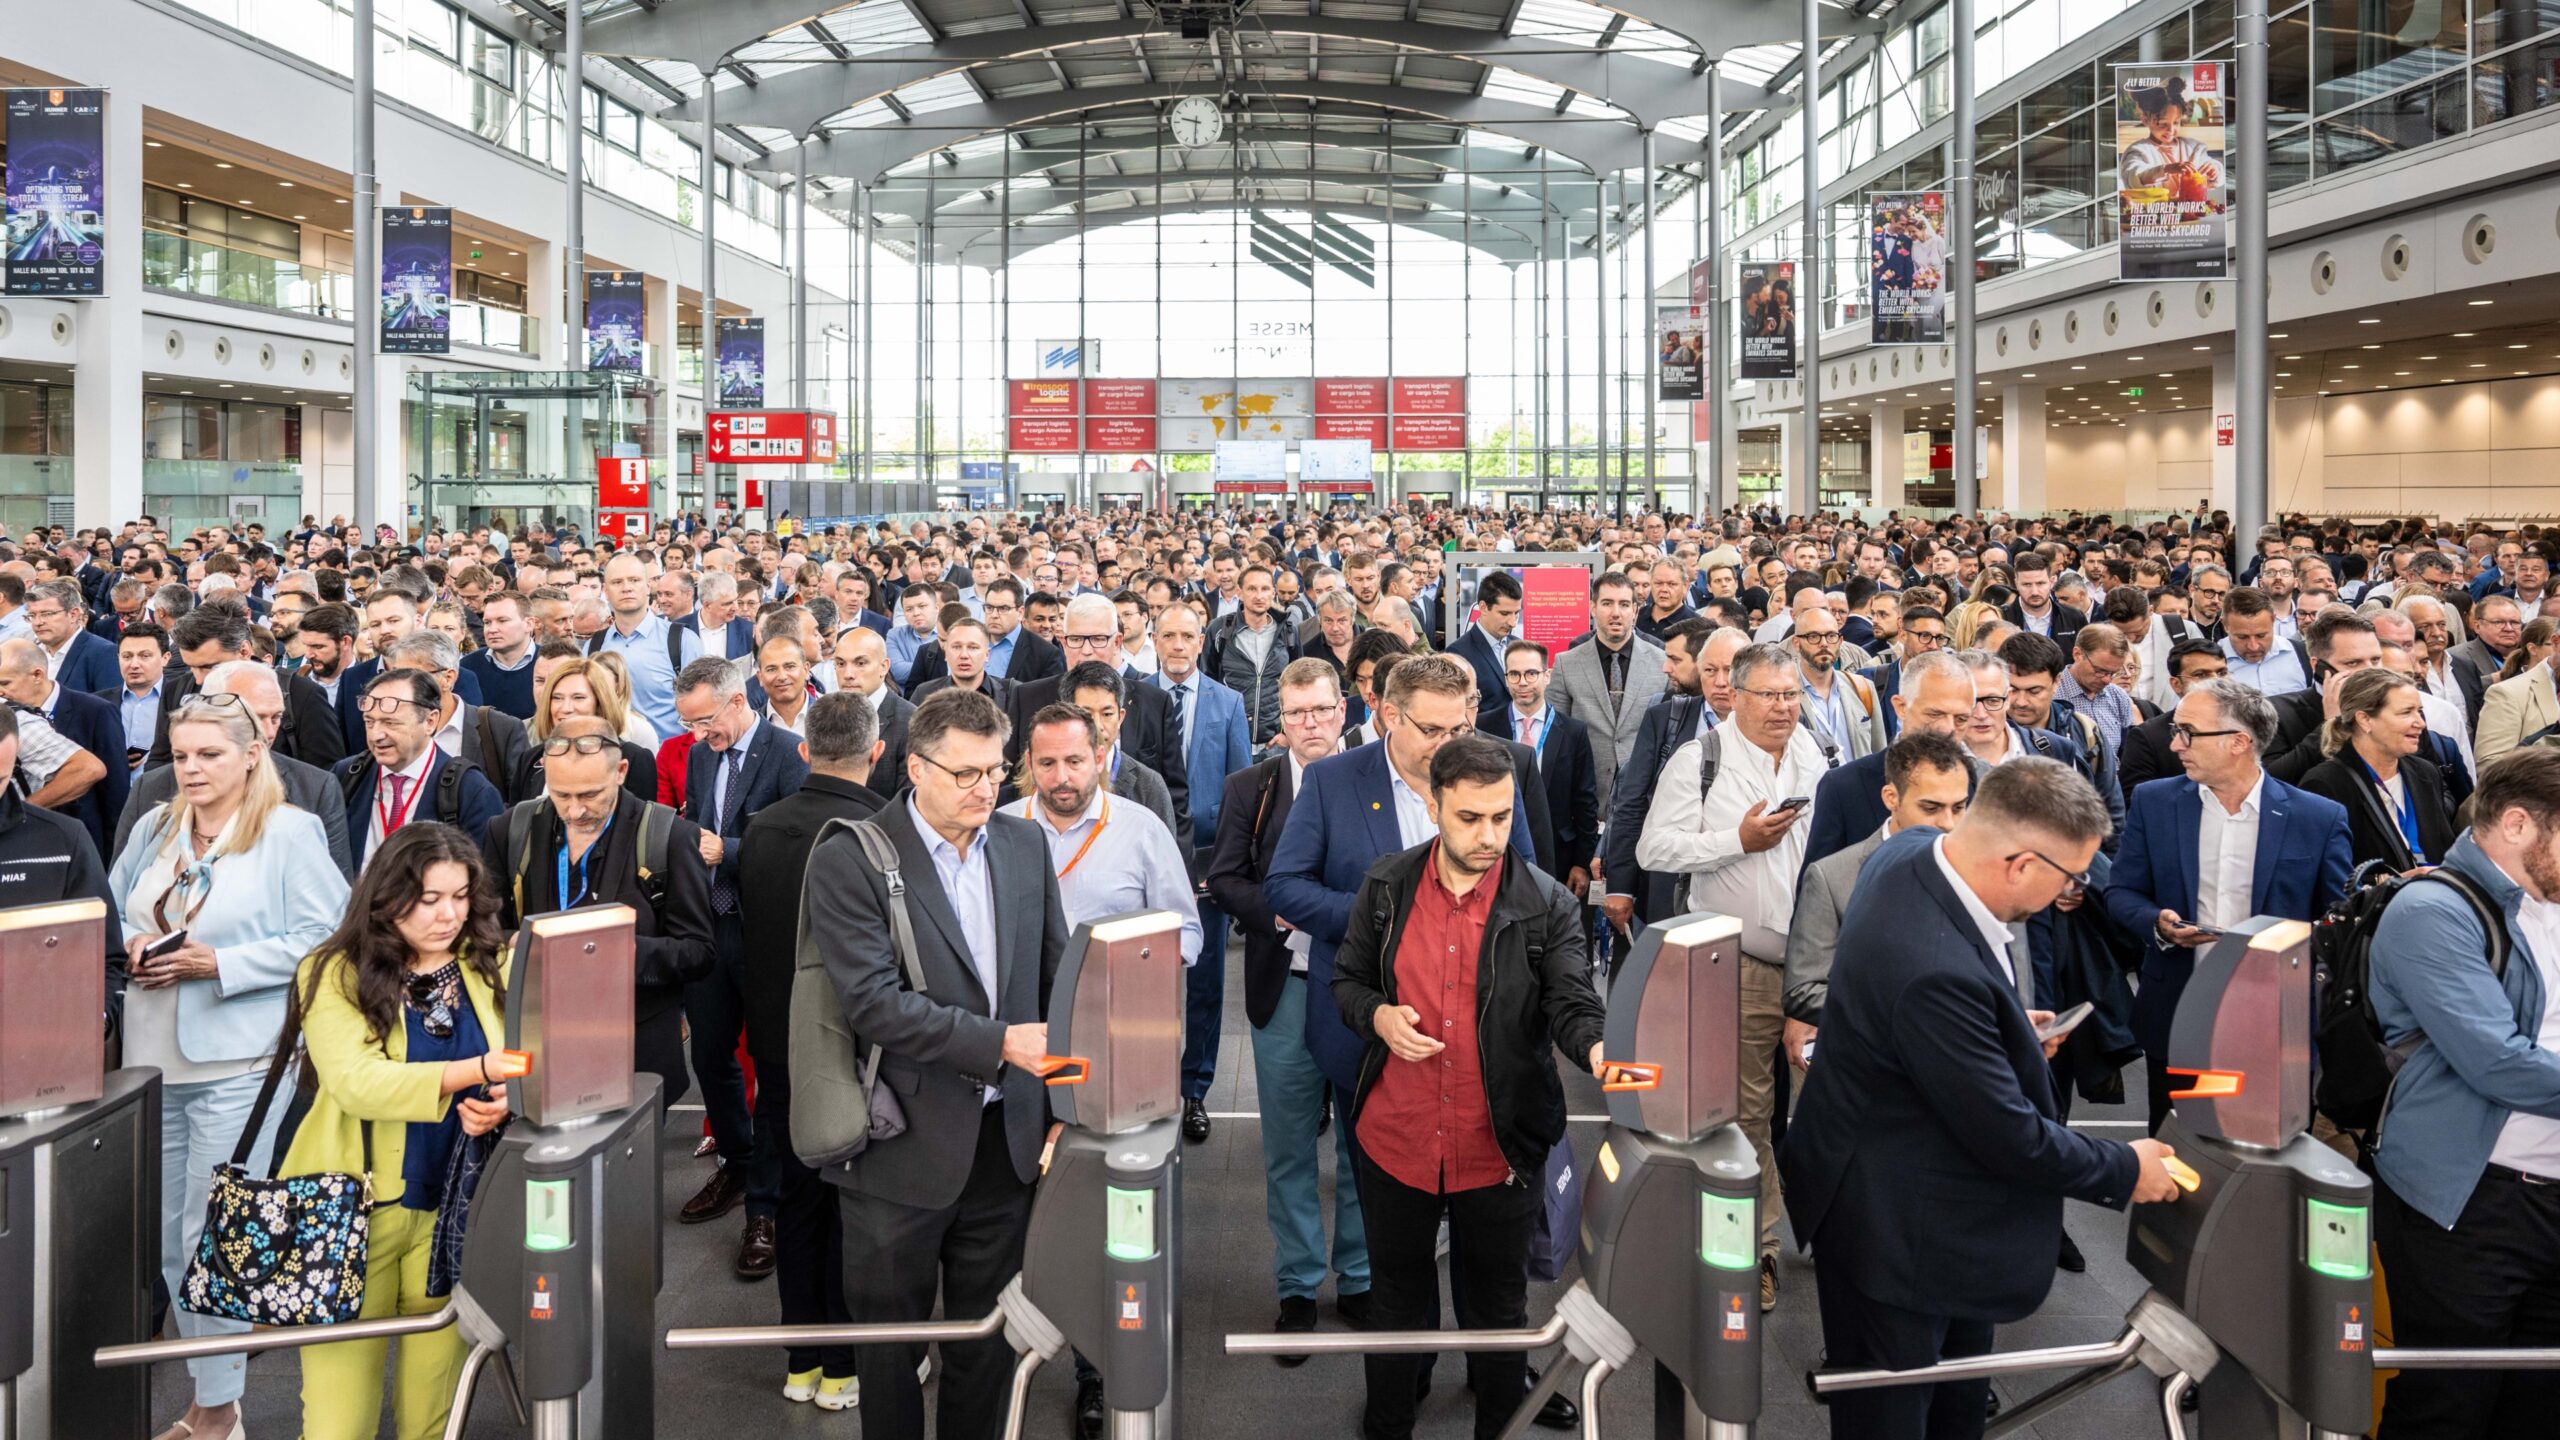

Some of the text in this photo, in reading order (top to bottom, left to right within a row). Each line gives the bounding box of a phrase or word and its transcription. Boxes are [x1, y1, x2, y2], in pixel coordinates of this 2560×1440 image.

[2127, 78, 2160, 87] FLY BETTER
[19, 194, 37, 202] TOTAL
[63, 194, 89, 202] STREAM
[2130, 202, 2206, 214] THE WORLD WORKS
[2130, 214, 2181, 225] BETTER WITH
[2130, 225, 2210, 237] EMIRATES SKYCARGO
[1906, 306, 1934, 314] SKYCARGO
[1030, 383, 1069, 391] transport
[1040, 389, 1070, 398] logistic
[2, 873, 26, 882] MIAS
[530, 1309, 552, 1320] EXIT
[1119, 1318, 1142, 1329] EXIT
[1723, 1329, 1747, 1340] EXIT
[2340, 1340, 2364, 1351] EXIT
